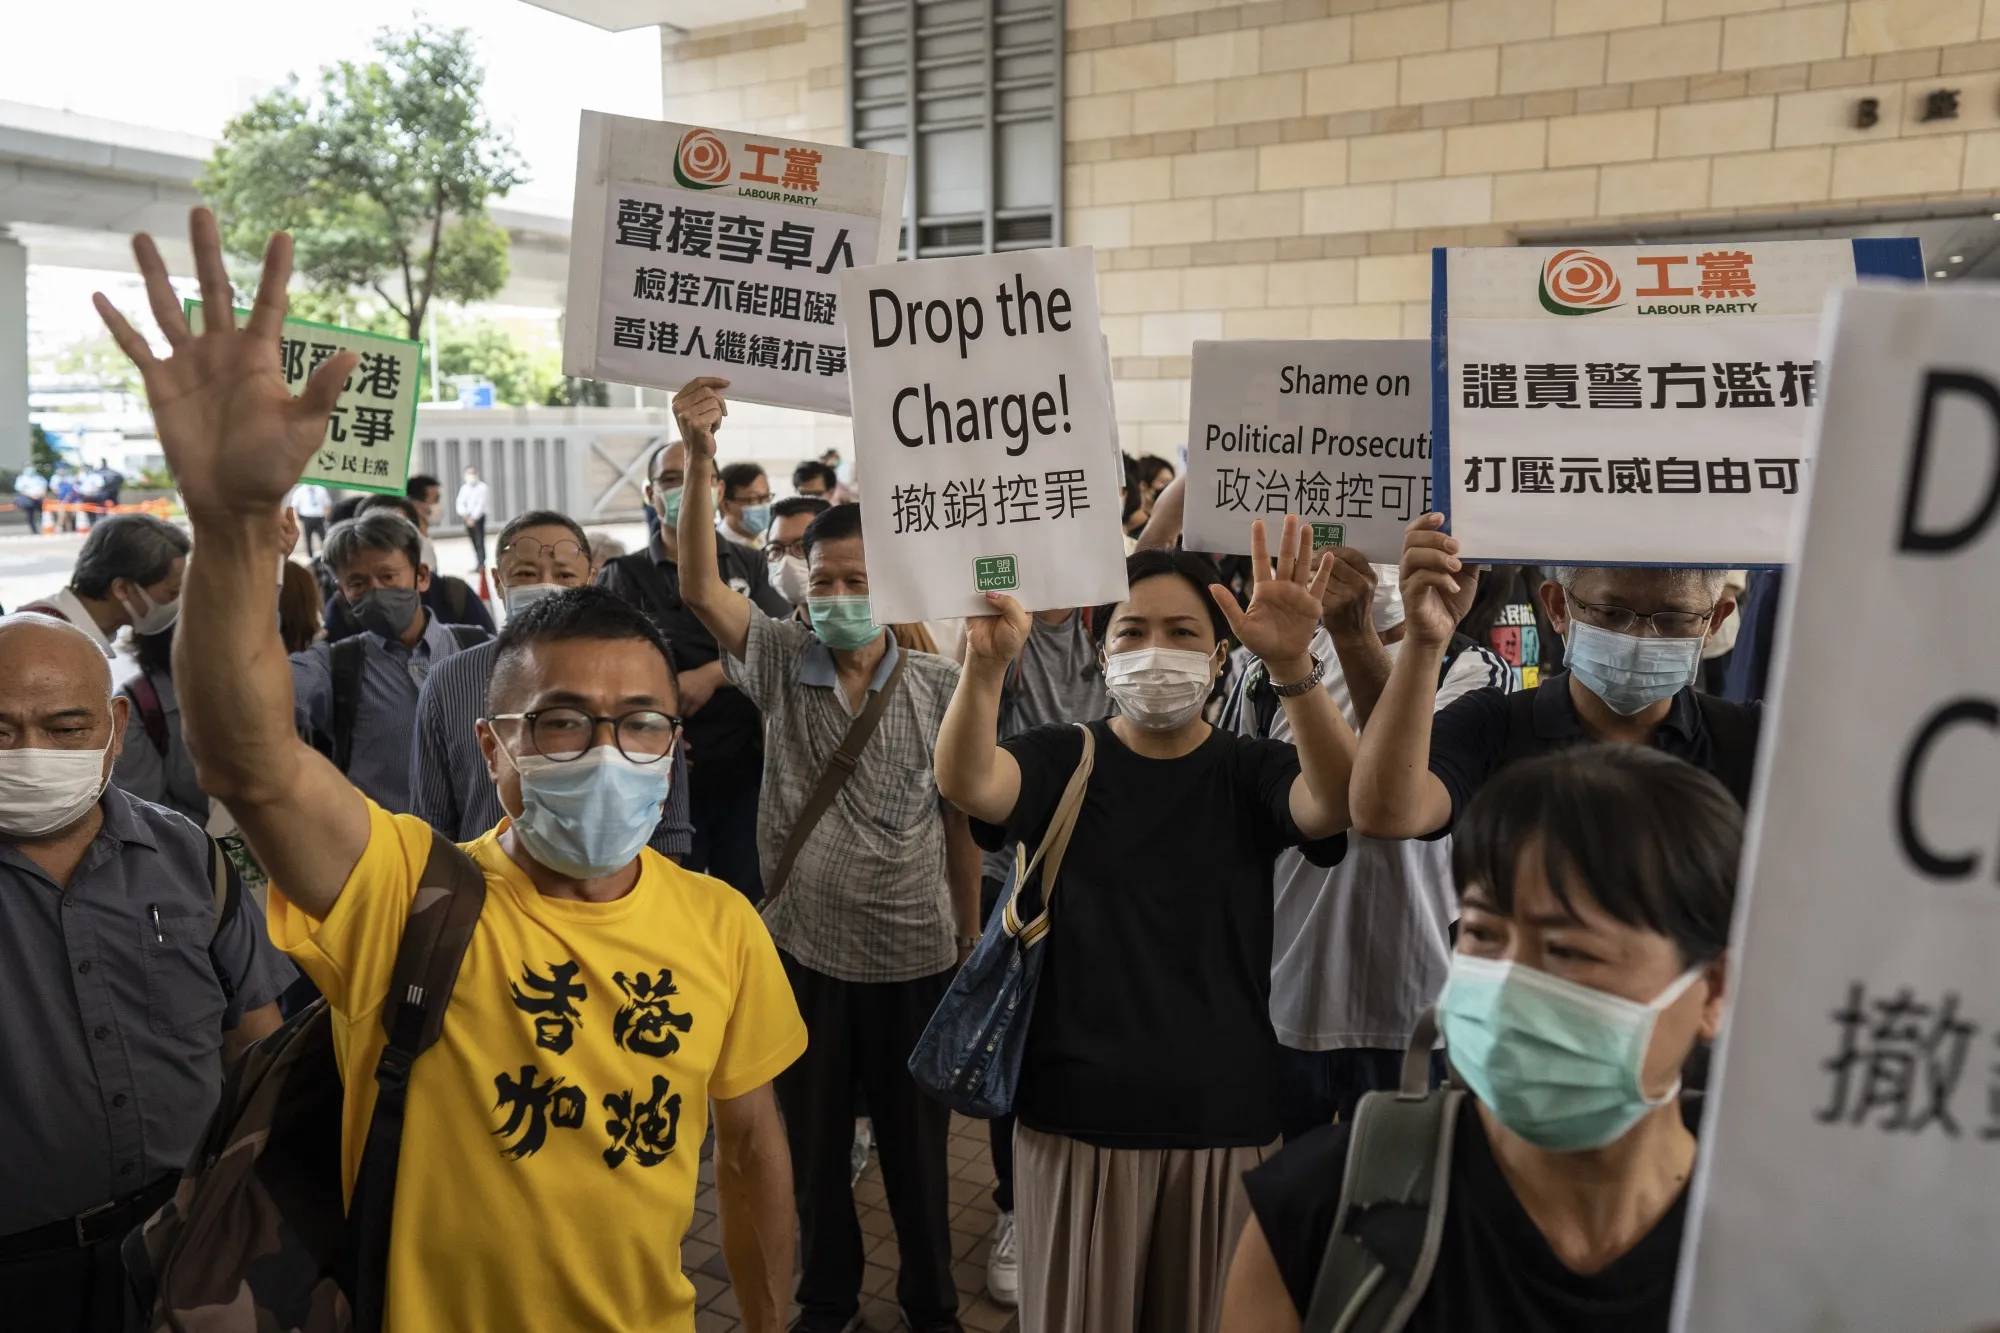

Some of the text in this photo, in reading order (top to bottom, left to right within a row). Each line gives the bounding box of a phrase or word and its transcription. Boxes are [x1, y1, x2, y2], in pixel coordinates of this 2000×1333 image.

[740, 144, 823, 193] 工黨
[738, 187, 818, 207] LABOUR PARTY
[615, 198, 855, 275] 聲援李卓人
[633, 266, 838, 326] 檢控不能阻礙
[1635, 250, 1757, 299] 工黨
[868, 273, 1072, 359] Drop the
[1637, 302, 1758, 315] LABOUR PARTY
[613, 315, 848, 377] 香港人繼續抗爭
[1279, 364, 1410, 397] Shame on
[892, 374, 1072, 457] Charge!
[1205, 423, 1304, 455] Political
[341, 454, 389, 477] 民主黨
[1463, 456, 1811, 495] 打壓示威自由可
[890, 468, 1091, 535] 撤銷控罪
[1313, 526, 1340, 539] 工盟
[979, 576, 1015, 587] HKCTU
[980, 558, 1011, 575] 工盟
[508, 960, 693, 1058] 香港
[1816, 980, 2000, 1141] 撤
[490, 1065, 682, 1170] 加油
